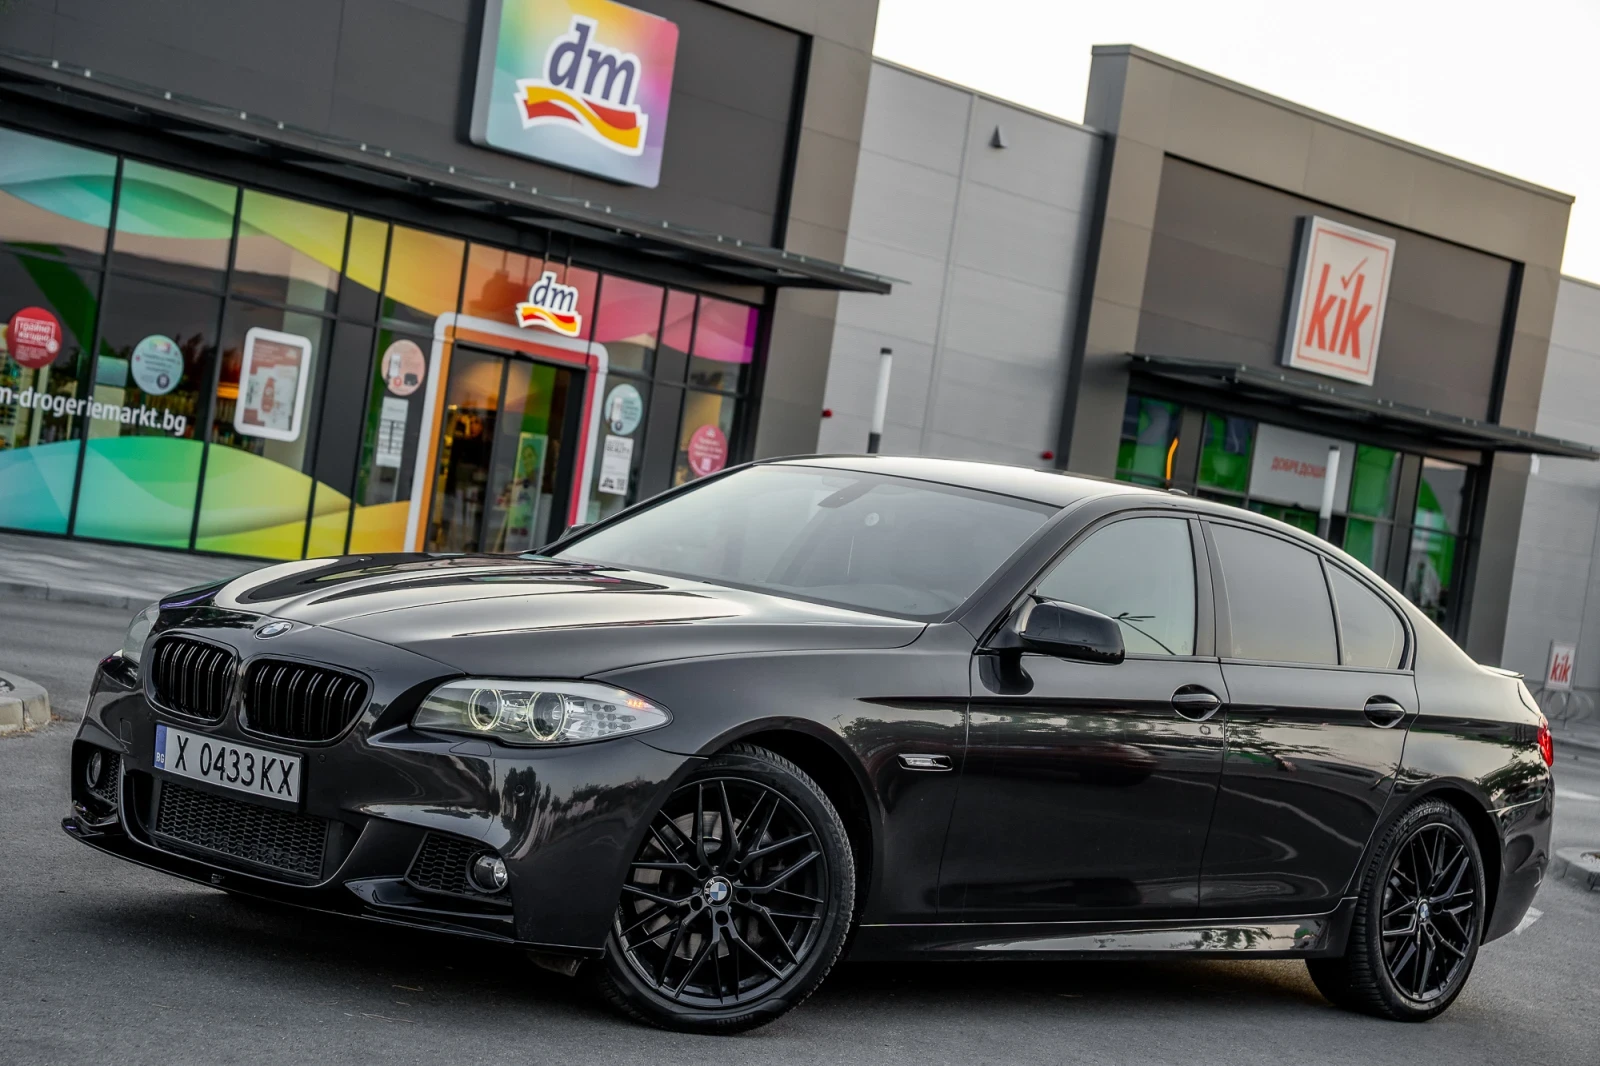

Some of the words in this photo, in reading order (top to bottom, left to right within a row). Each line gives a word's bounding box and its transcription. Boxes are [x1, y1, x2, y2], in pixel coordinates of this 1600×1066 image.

[548, 22, 636, 106] dm
[532, 274, 576, 314] dm
[1305, 260, 1373, 360] kik
[1550, 652, 1571, 684] kik
[156, 752, 165, 764] BG
[174, 735, 189, 772] X
